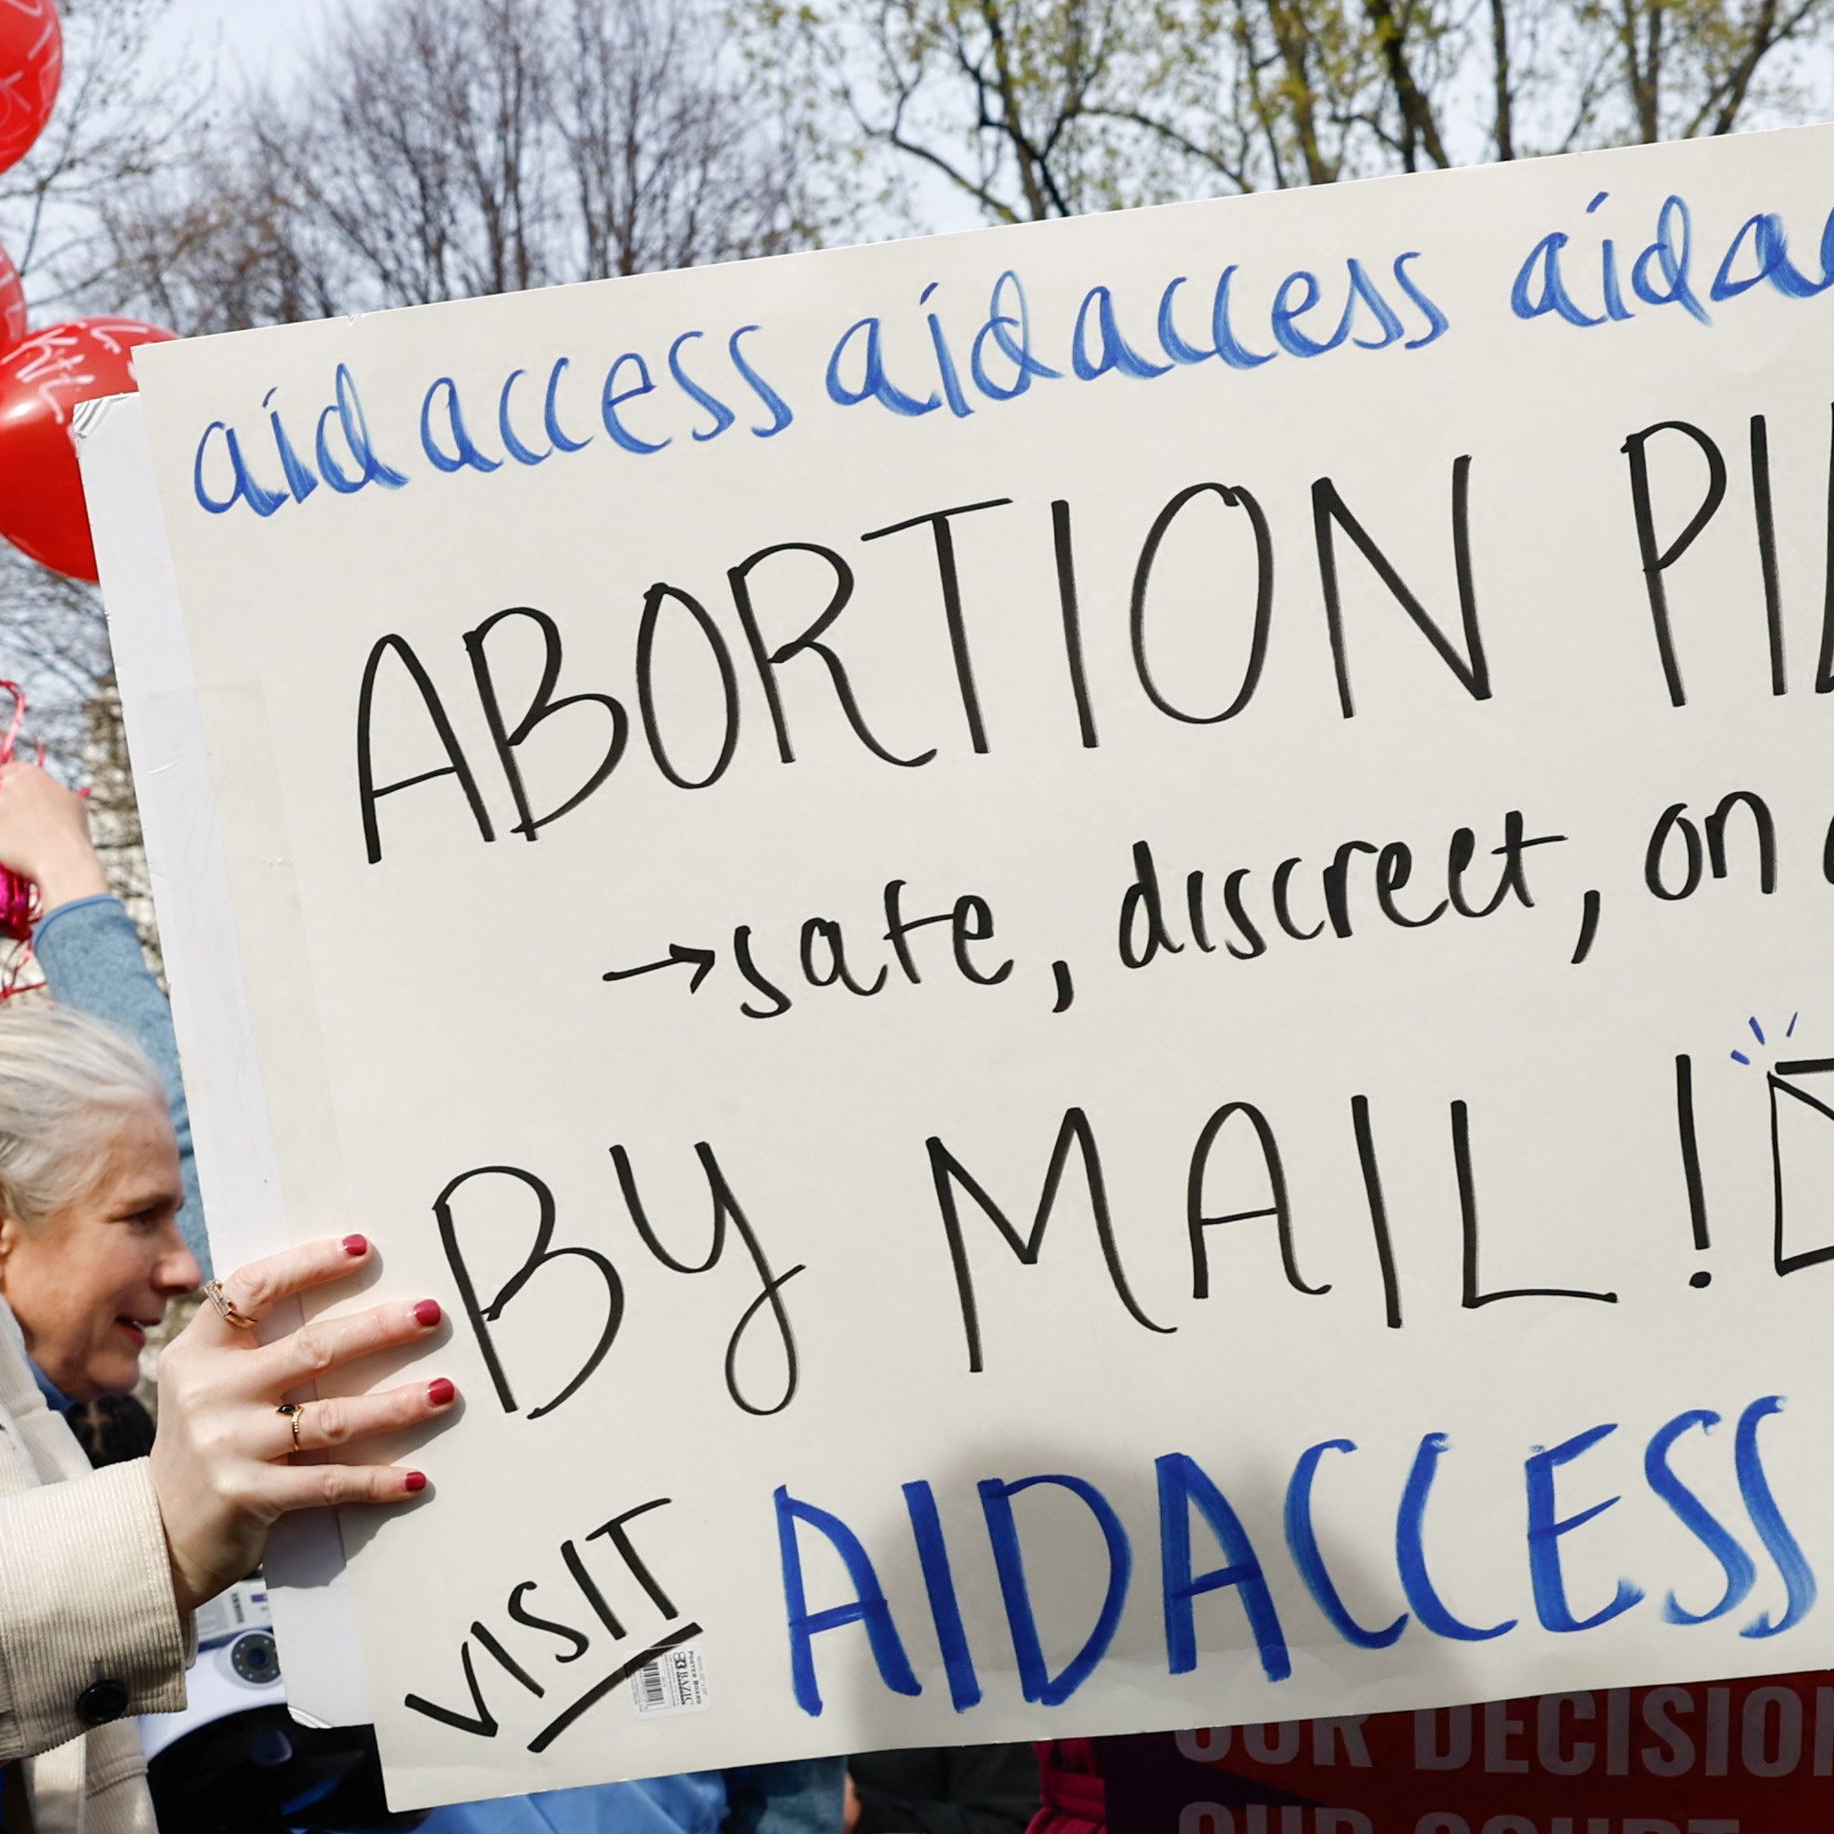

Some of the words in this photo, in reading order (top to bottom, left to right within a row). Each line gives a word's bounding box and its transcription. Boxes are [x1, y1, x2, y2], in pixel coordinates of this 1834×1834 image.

[357, 454, 1494, 865] ABORTION
[733, 880, 1074, 1018] safe,
[1118, 811, 1601, 968] discreet,
[1644, 790, 1775, 901] on
[432, 1142, 807, 1420] BY
[925, 1094, 1618, 1373] MAIL
[403, 1497, 679, 1738] VISIT
